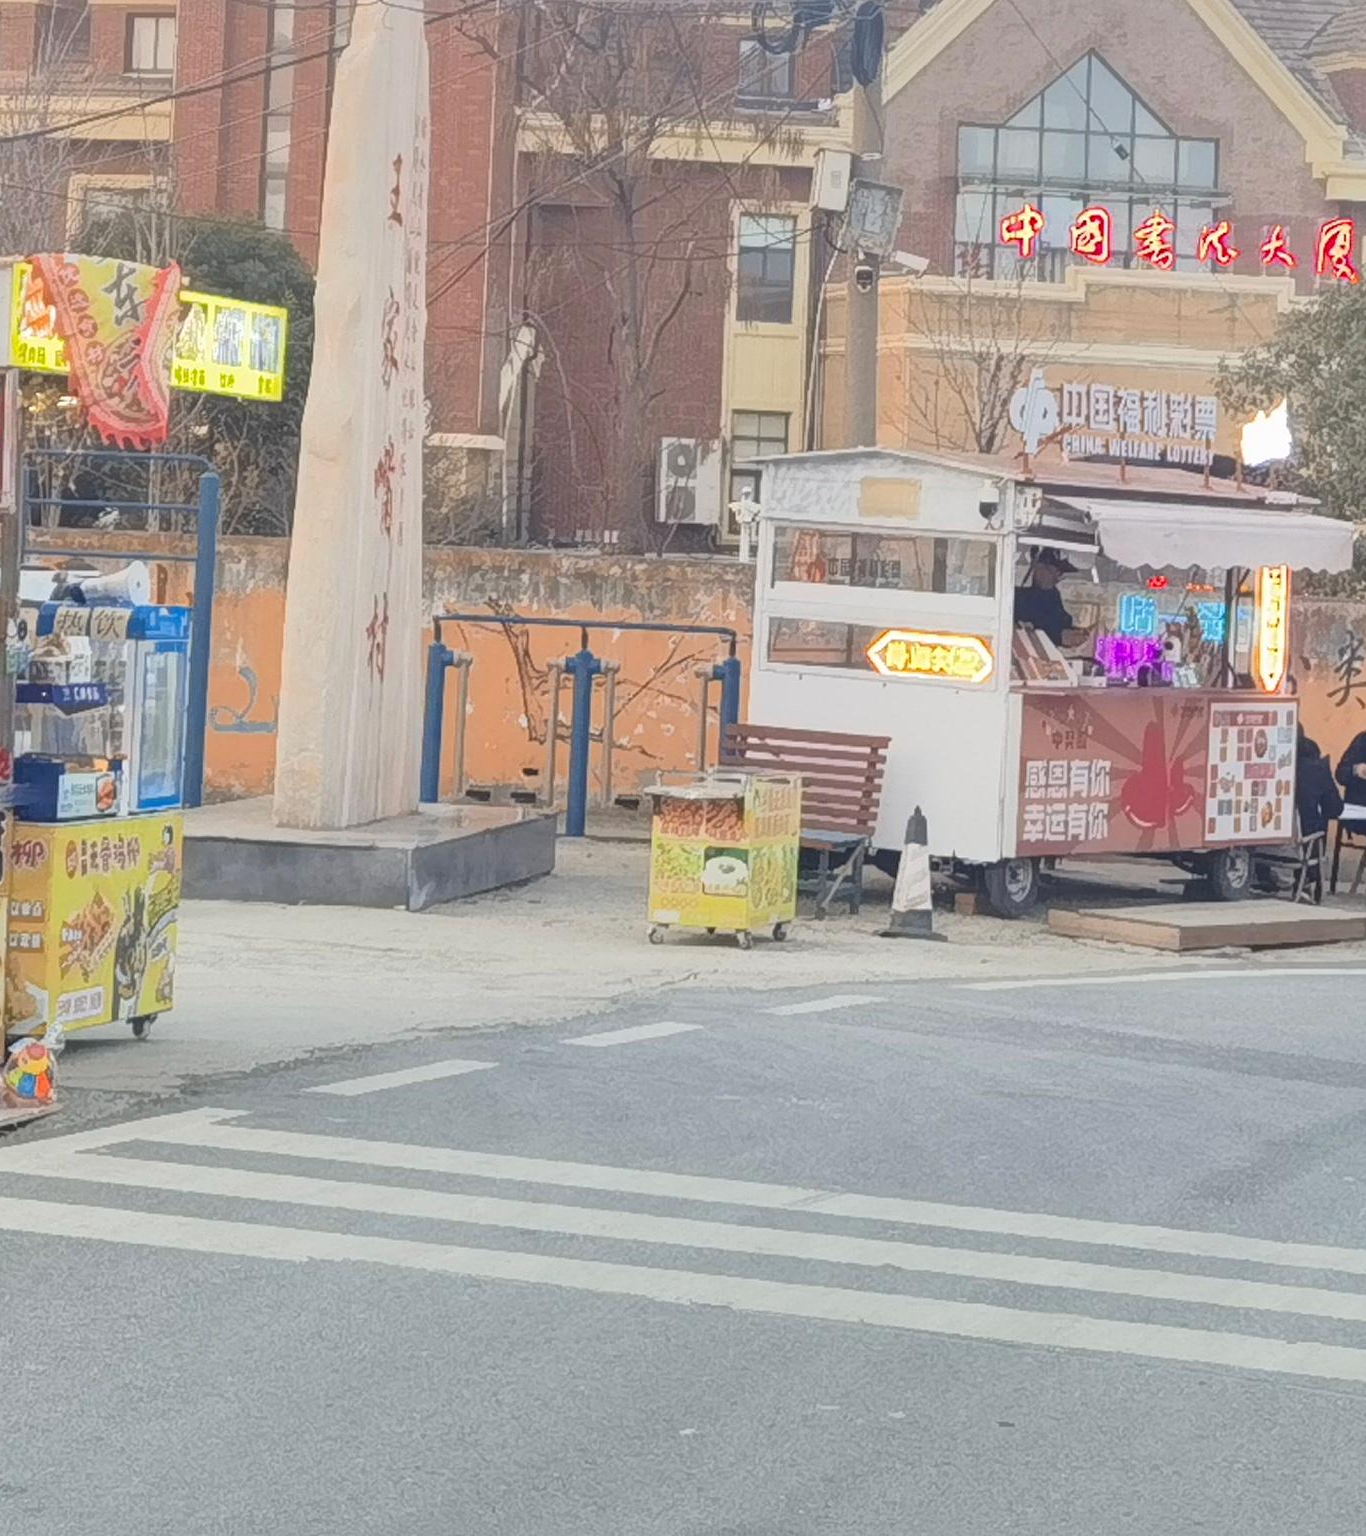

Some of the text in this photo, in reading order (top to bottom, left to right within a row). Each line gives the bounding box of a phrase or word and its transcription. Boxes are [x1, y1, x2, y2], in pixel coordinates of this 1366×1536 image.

[998, 202, 1361, 284] 中国书法大厦
[1063, 383, 1219, 441] 中国福利彩票
[1109, 439, 1162, 460] WELFARE
[1166, 443, 1215, 466] LOTTERY
[57, 609, 125, 639] 热饮
[1024, 759, 1112, 799] 感恩有你
[1022, 801, 1109, 843] 幸运有你
